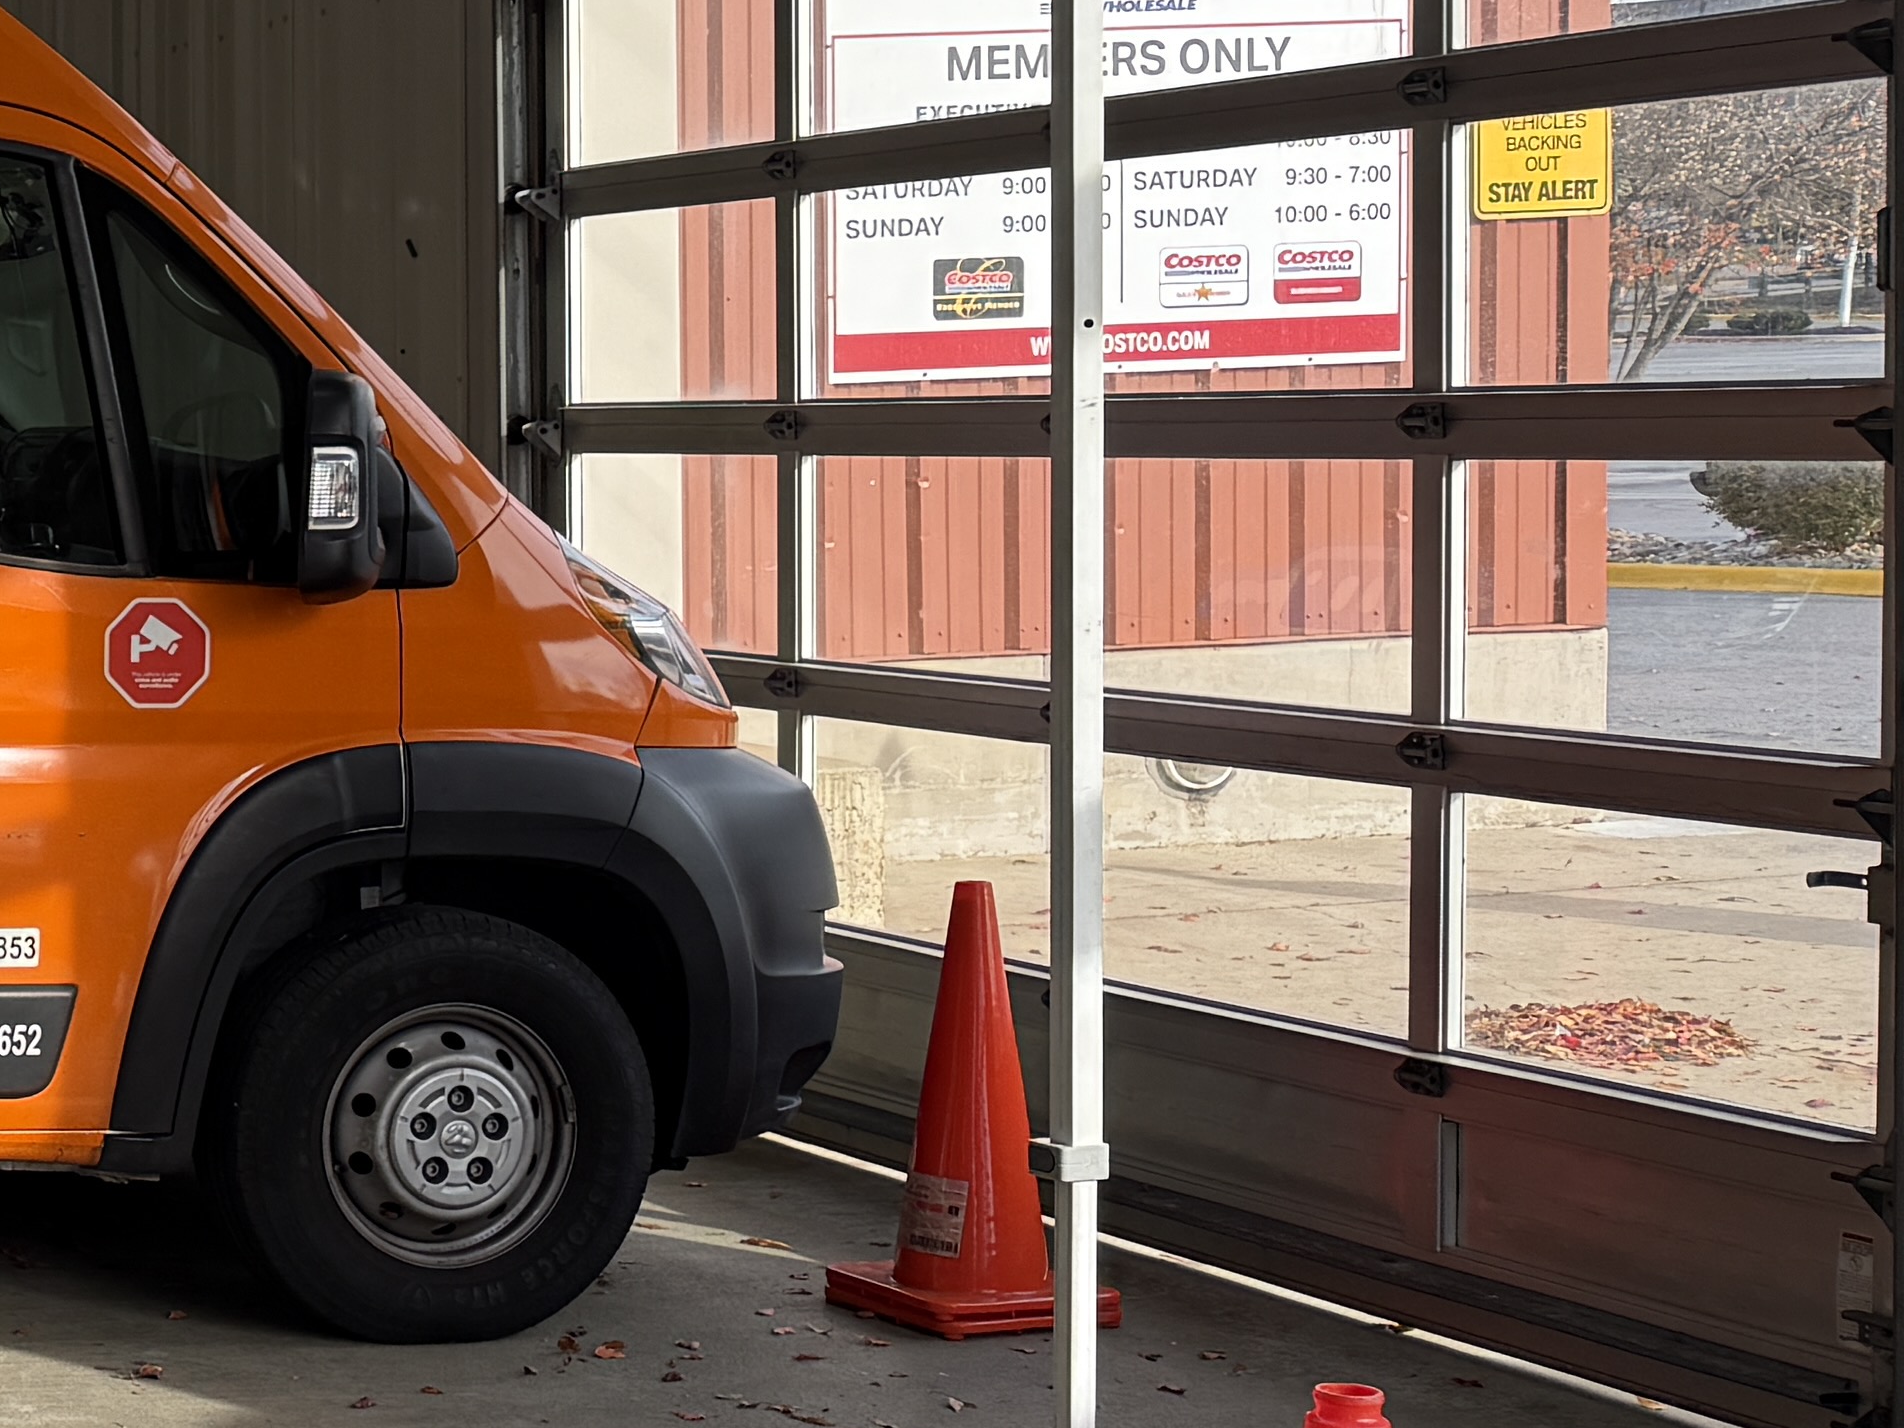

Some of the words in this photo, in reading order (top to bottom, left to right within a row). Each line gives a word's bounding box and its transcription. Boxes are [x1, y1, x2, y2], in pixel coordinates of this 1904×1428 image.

[1103, 0, 1197, 13] HOLESALE
[947, 39, 1166, 82] MEMRS
[1180, 36, 1291, 74] ONLY
[1502, 113, 1587, 131] VEHICLES
[1506, 134, 1581, 152] BACKING
[1525, 156, 1561, 171] OUT
[1002, 177, 1046, 195] 9:00
[1134, 167, 1257, 190] SATURDAY
[1286, 168, 1327, 185] 9:30
[1349, 166, 1391, 183] 7:00
[1488, 181, 1534, 203] STAY
[1537, 179, 1598, 201] ALERT
[1134, 207, 1228, 228] SUNDAY
[1275, 205, 1328, 223] 10:00
[1349, 203, 1391, 221] 6:00
[846, 217, 944, 239] SUNDAY
[1003, 215, 1046, 233] 9:00
[1164, 253, 1242, 269] COSTCO
[1277, 249, 1354, 265] COSTCO
